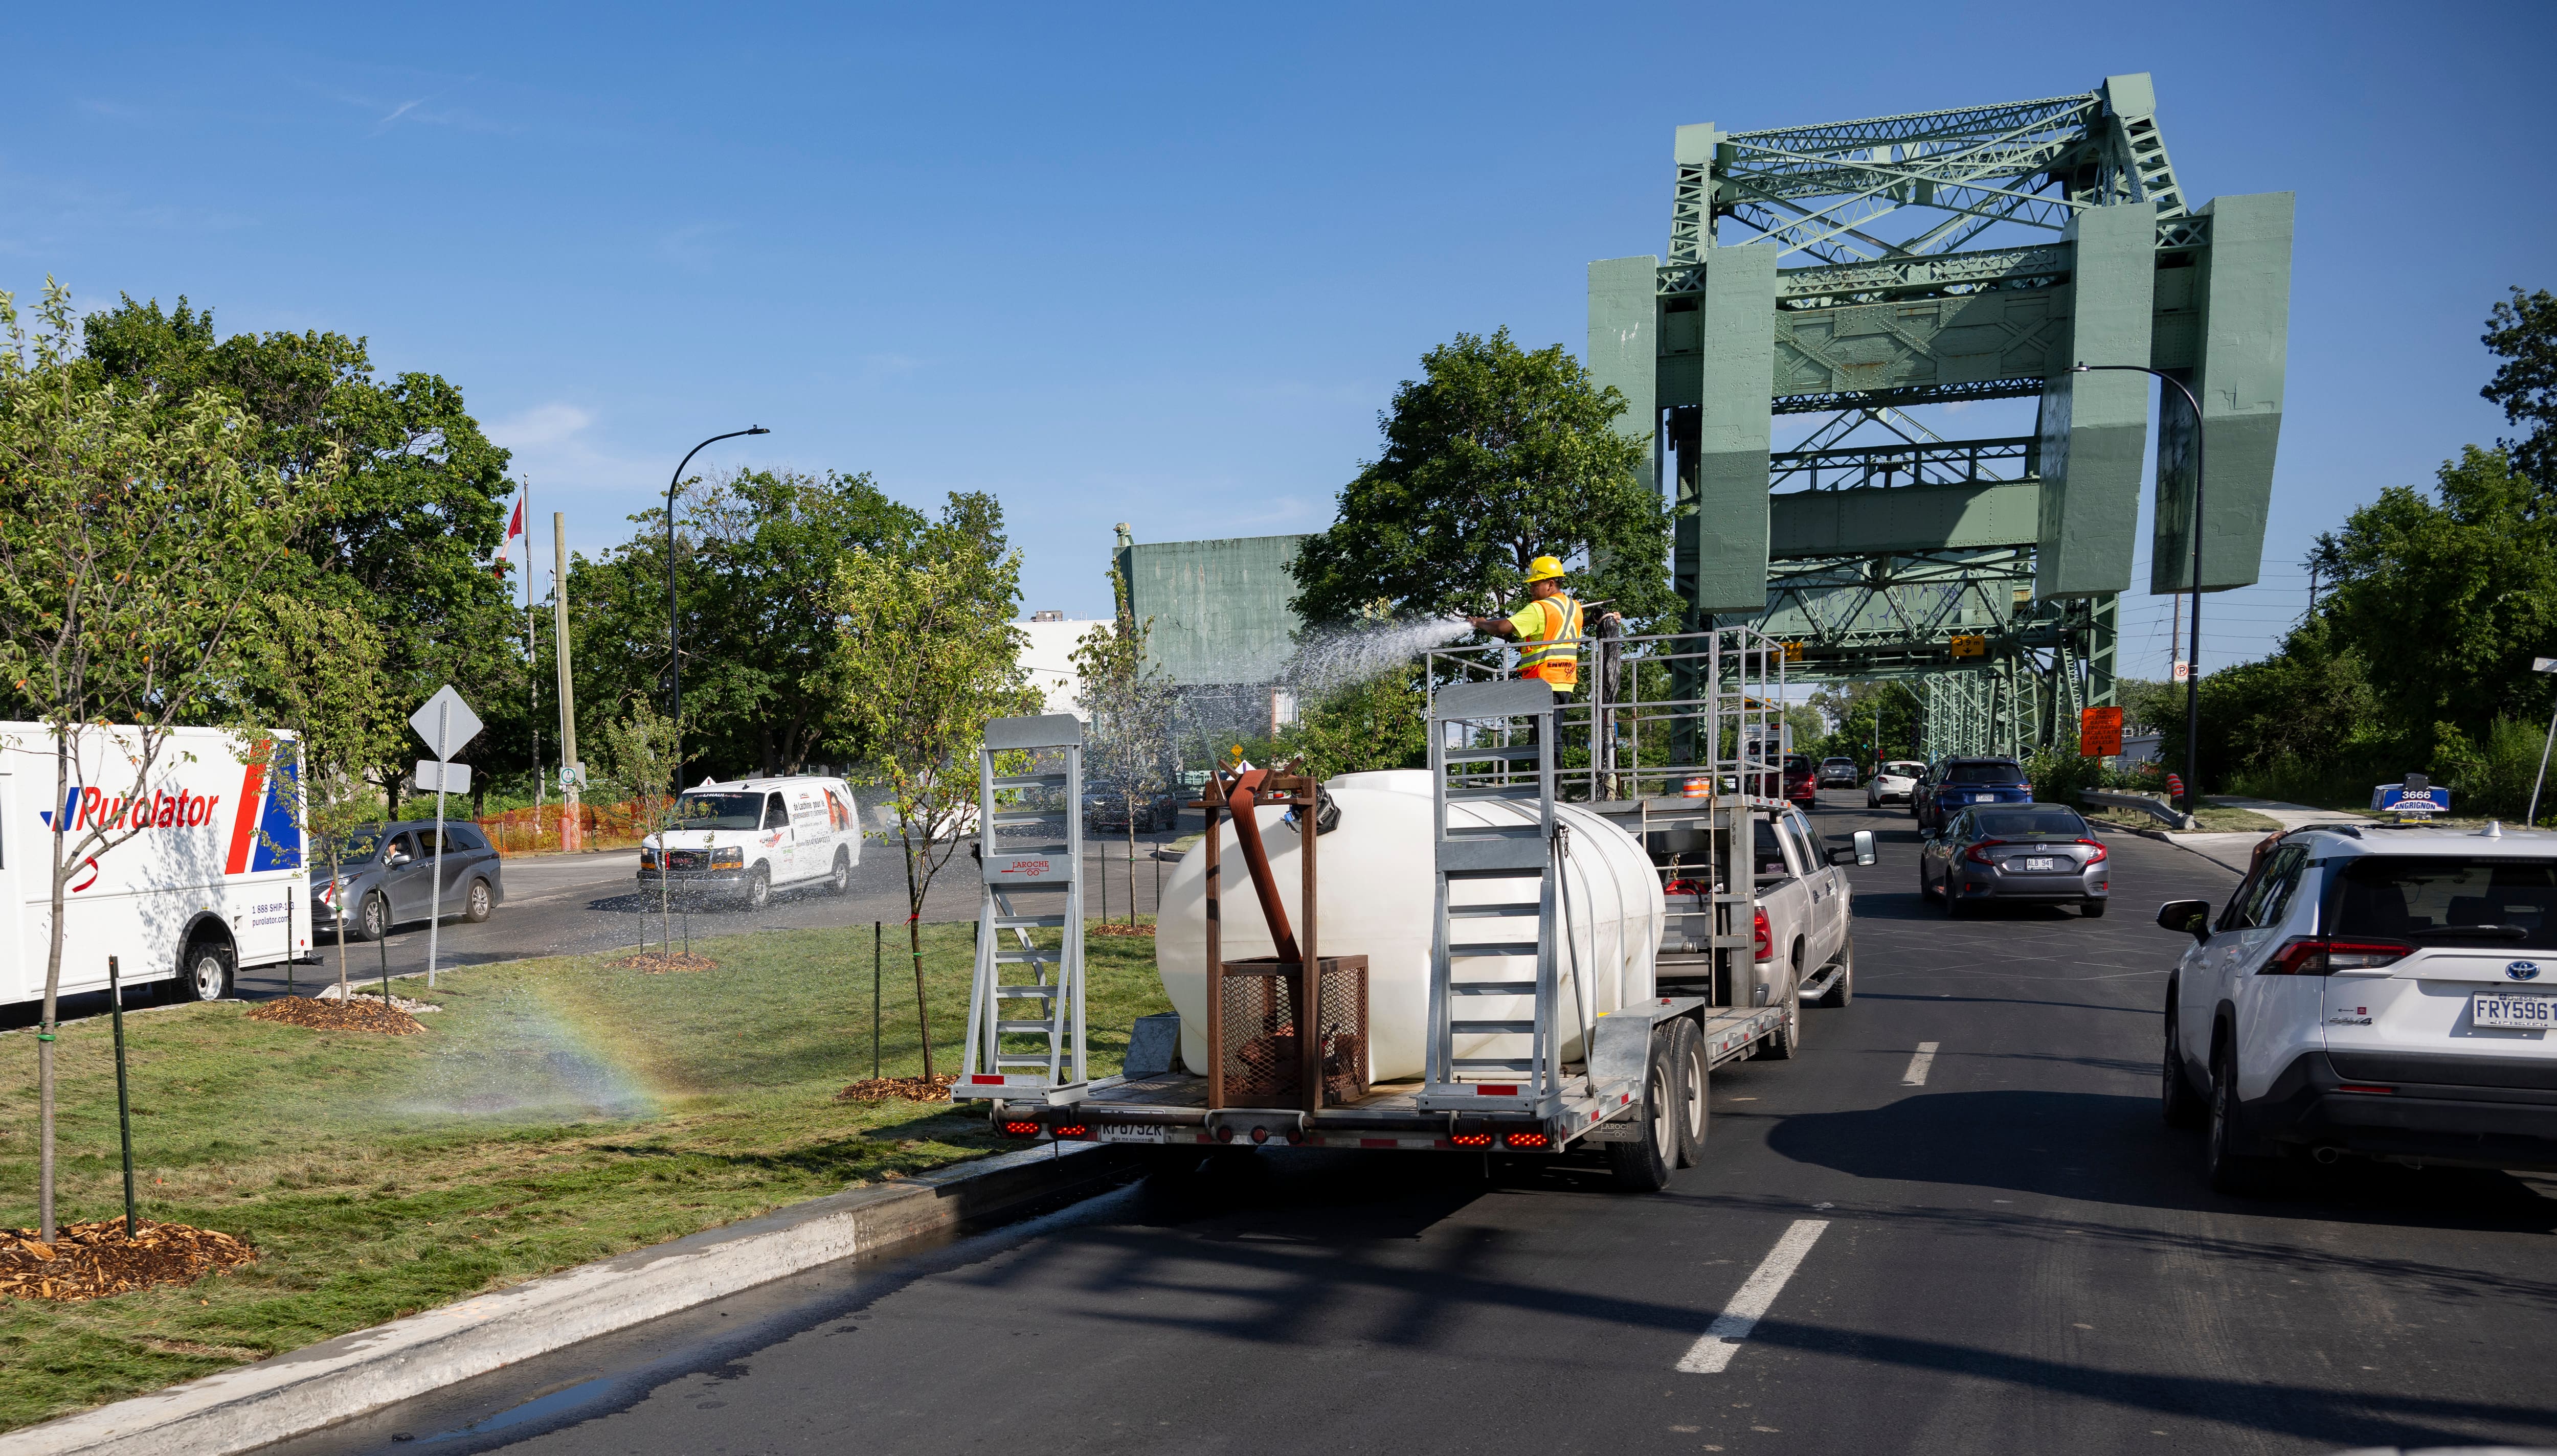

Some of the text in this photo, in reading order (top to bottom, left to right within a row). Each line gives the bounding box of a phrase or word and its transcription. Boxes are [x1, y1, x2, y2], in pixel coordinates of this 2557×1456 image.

[2402, 791, 2431, 799] 3666
[76, 787, 219, 831] Purolator
[794, 803, 798, 811] de
[798, 801, 812, 810] Lachine
[2394, 802, 2436, 810] ANGRIGNON
[805, 838, 815, 847] (514)
[252, 901, 295, 914] 1 888 SHIP-13
[253, 916, 289, 928] purolator.com
[2477, 1000, 2557, 1020] FRY5961
